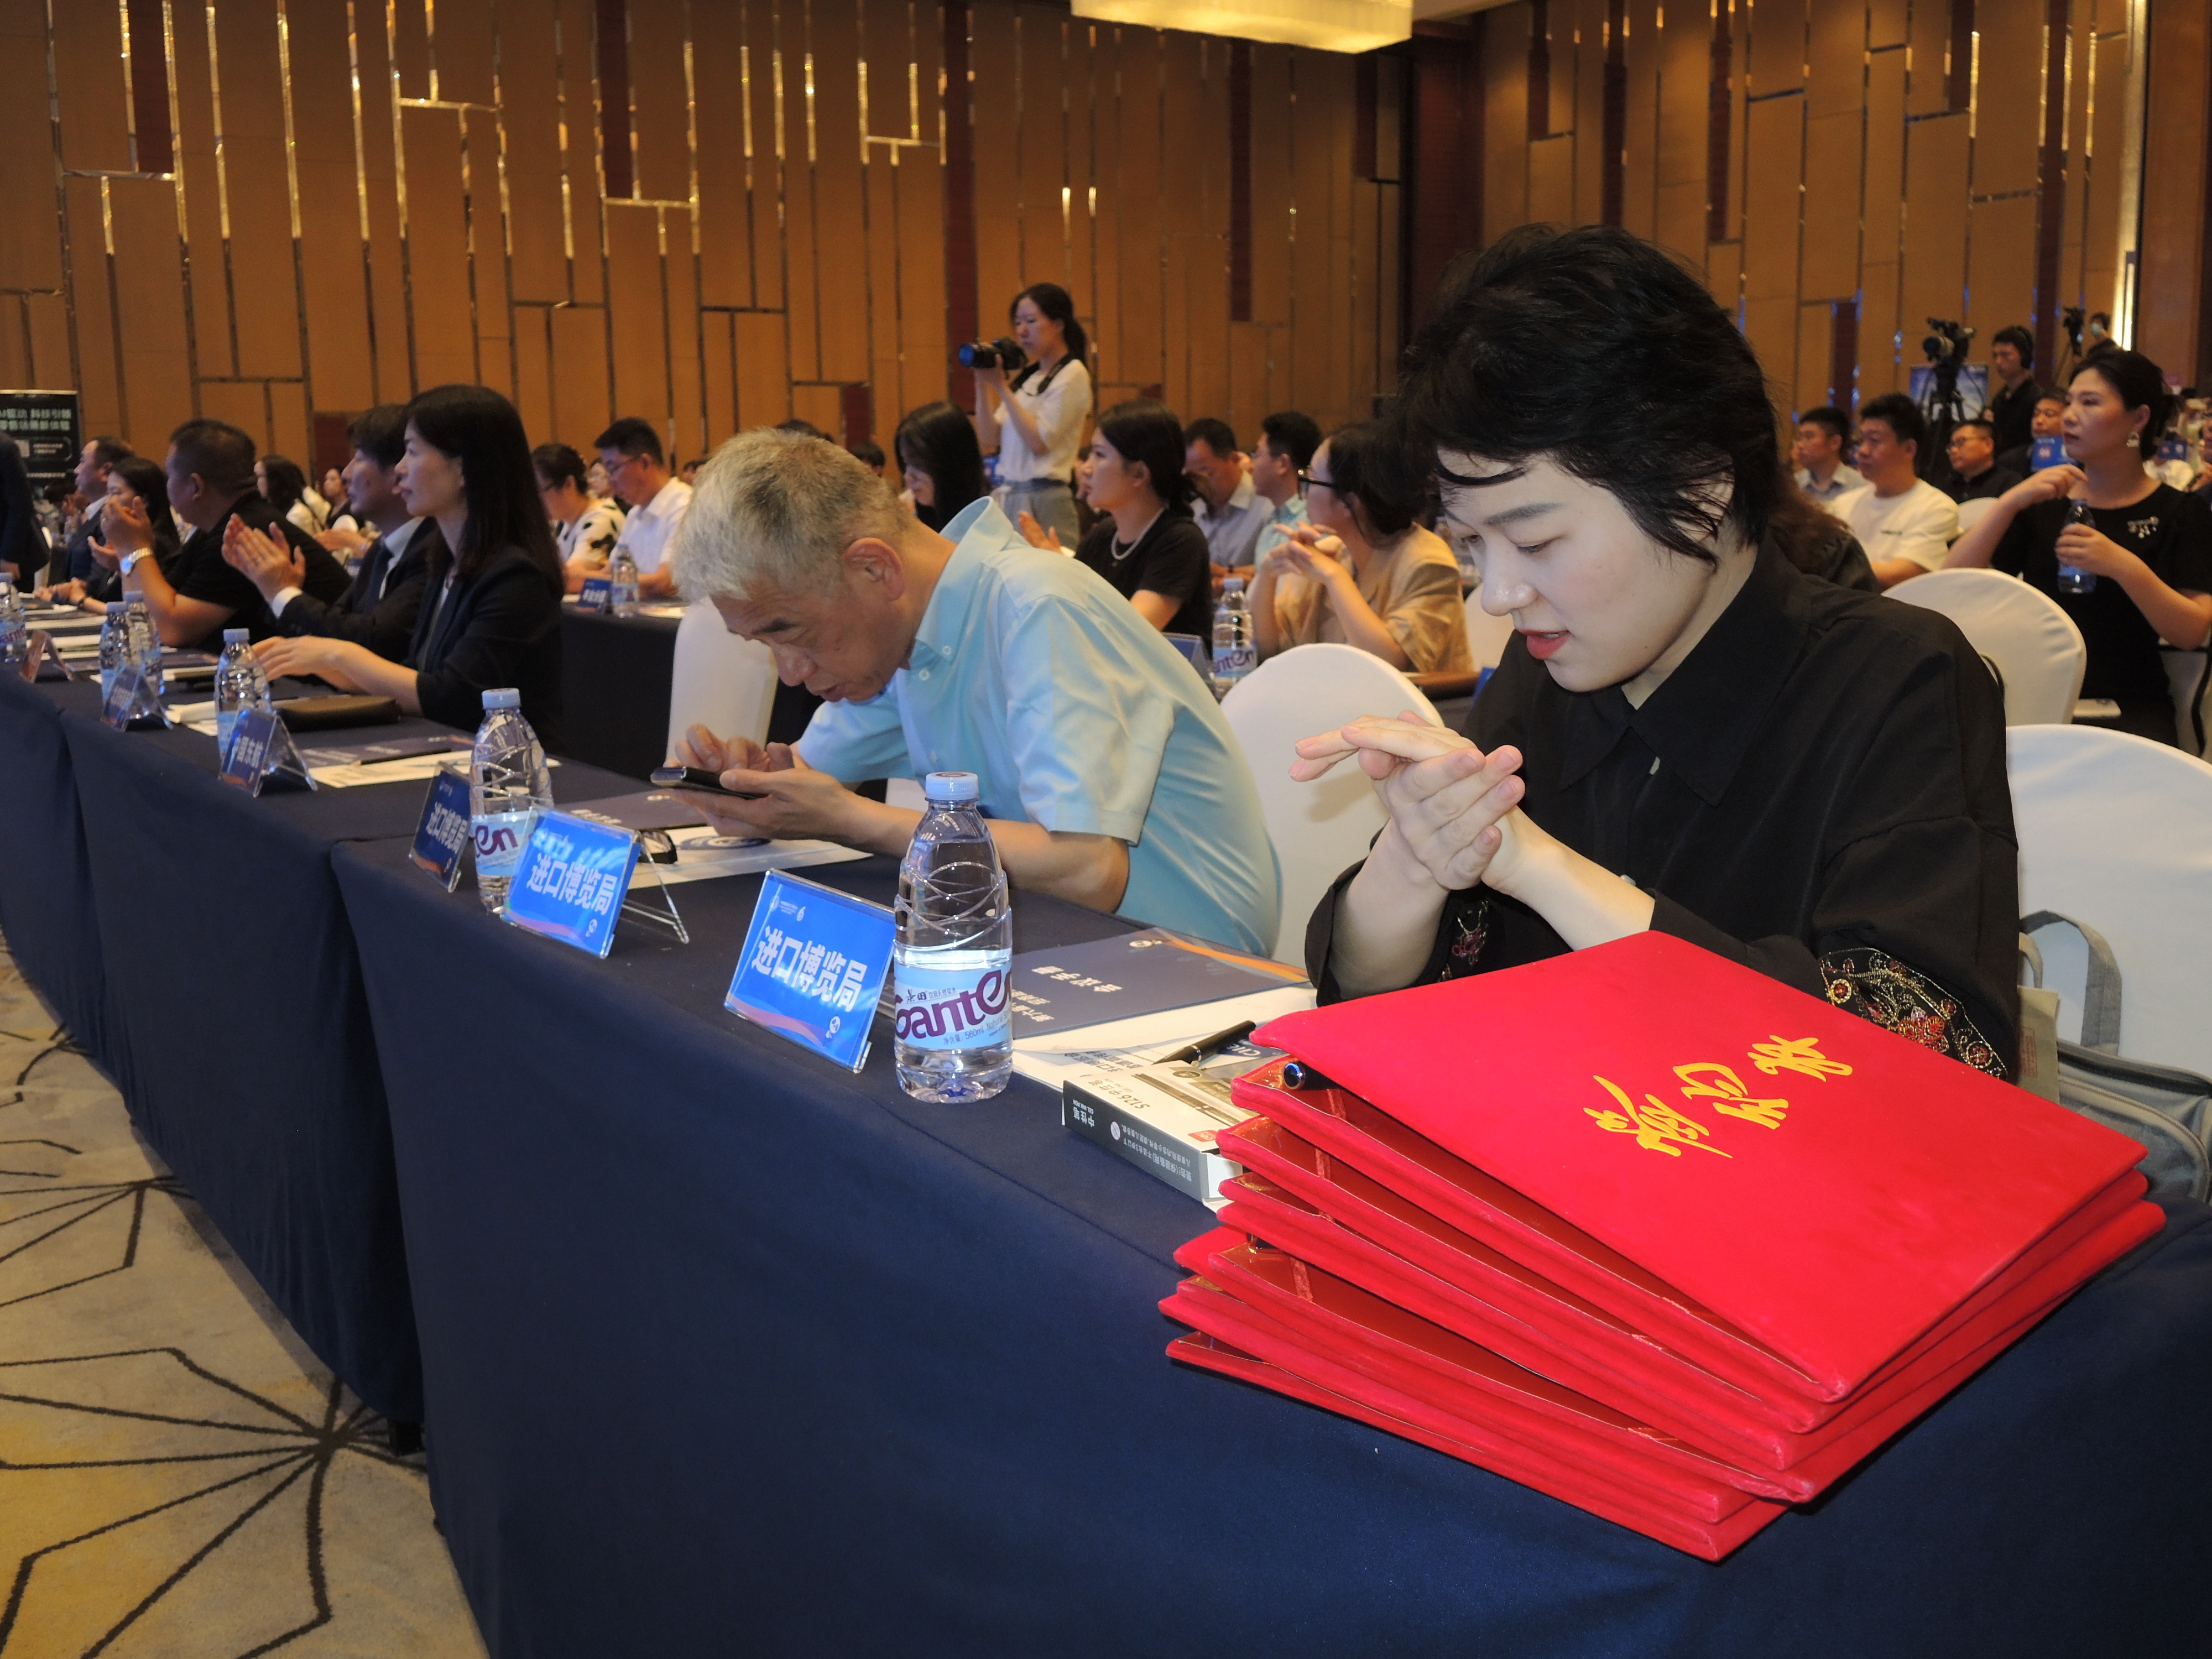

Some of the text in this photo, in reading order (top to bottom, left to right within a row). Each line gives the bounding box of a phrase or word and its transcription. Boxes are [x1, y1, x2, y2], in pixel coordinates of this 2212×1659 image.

[426, 801, 468, 854] 进口博览局
[526, 852, 618, 915] 进口博览局
[752, 926, 867, 1011] 进口博览局
[1073, 1107, 1094, 1127] 中性笔
[1117, 1094, 1150, 1109] S126
